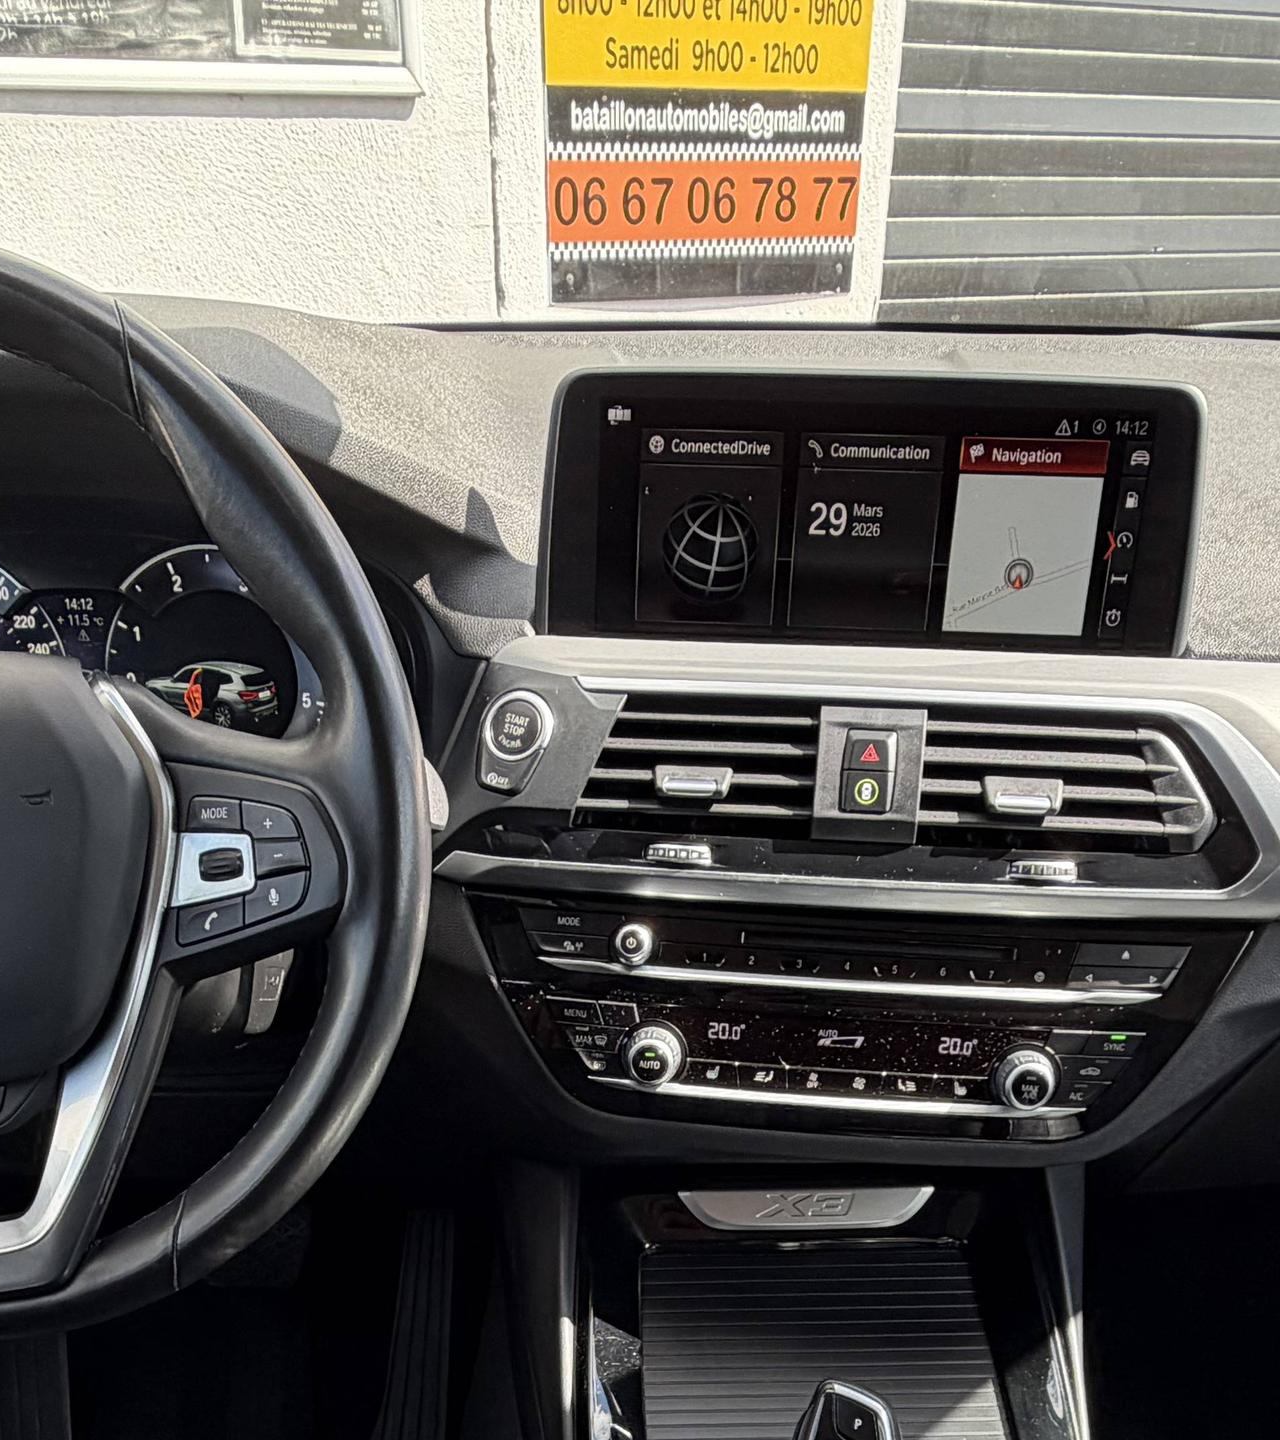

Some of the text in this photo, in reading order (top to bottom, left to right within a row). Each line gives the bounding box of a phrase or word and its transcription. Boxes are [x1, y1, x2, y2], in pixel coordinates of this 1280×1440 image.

[702, 0, 721, 21] et
[730, 0, 787, 23] 14h00
[807, 0, 863, 26] 19h00
[605, 37, 680, 69] Samedi
[692, 40, 744, 72] 9h00
[763, 42, 819, 74] 12h00
[571, 100, 846, 139] bataillonautomobiles@gmail.com
[554, 176, 858, 226] 06 67 06 78 77
[1115, 421, 1149, 436] 14:12
[671, 438, 771, 455] ConnectedDrive
[830, 443, 930, 460] Communication
[992, 447, 1062, 466] Navigation
[808, 502, 883, 536] 29 Mars
[851, 522, 881, 537] 2026
[171, 575, 183, 593] 2
[64, 598, 94, 611] 14:12
[13, 615, 36, 629] 220
[132, 625, 141, 642] 1
[27, 643, 50, 655] 240
[301, 692, 312, 708] 5
[505, 712, 530, 727] START
[503, 723, 525, 737] STOP
[201, 807, 228, 820] MODE
[557, 916, 581, 926] MODE
[564, 1008, 587, 1018] MENU
[818, 1029, 838, 1038] AUTO
[1103, 1042, 1126, 1051] SYNC
[638, 1059, 660, 1070] AUTO
[1021, 1084, 1039, 1093] MAX
[853, 1418, 863, 1431] P
